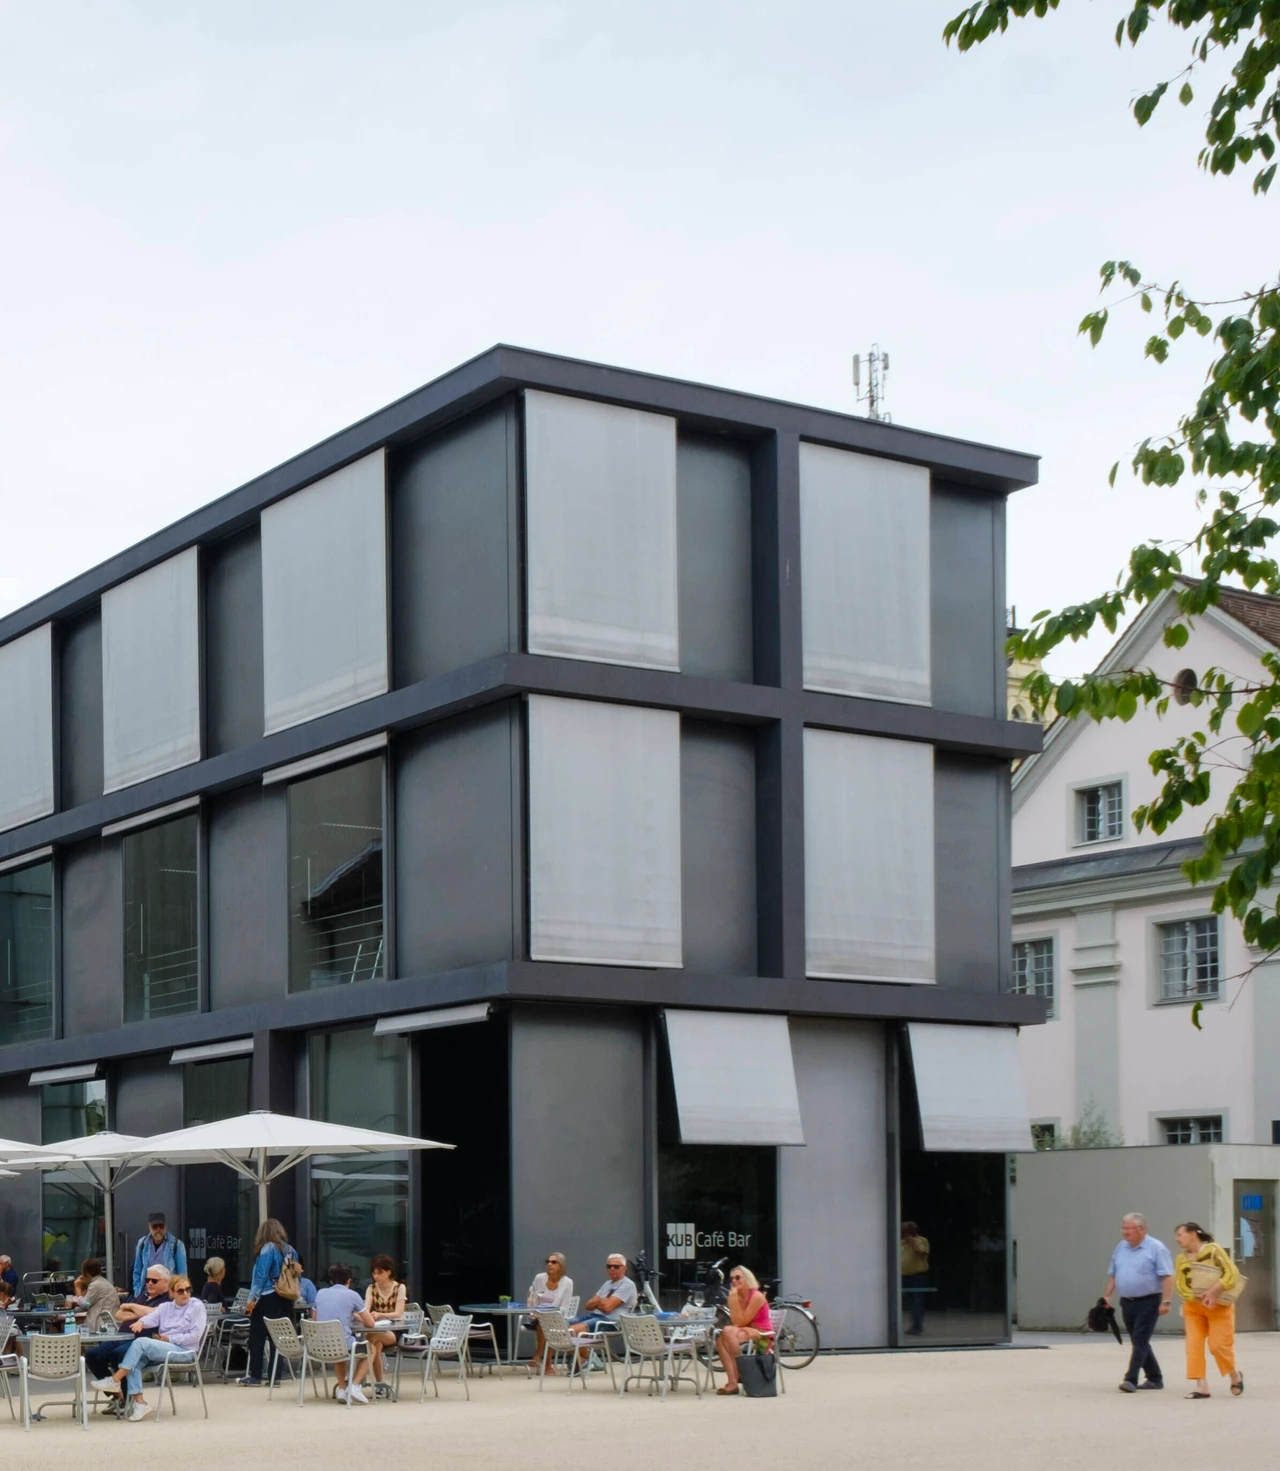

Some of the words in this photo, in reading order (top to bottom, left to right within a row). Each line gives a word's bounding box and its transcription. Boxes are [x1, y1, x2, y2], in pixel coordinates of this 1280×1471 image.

[189, 1237, 205, 1249] KUB
[207, 1235, 225, 1249] Café
[227, 1235, 242, 1249] Bar
[667, 1233, 693, 1247] KUB
[696, 1231, 725, 1247] Café
[728, 1231, 751, 1247] Bar
